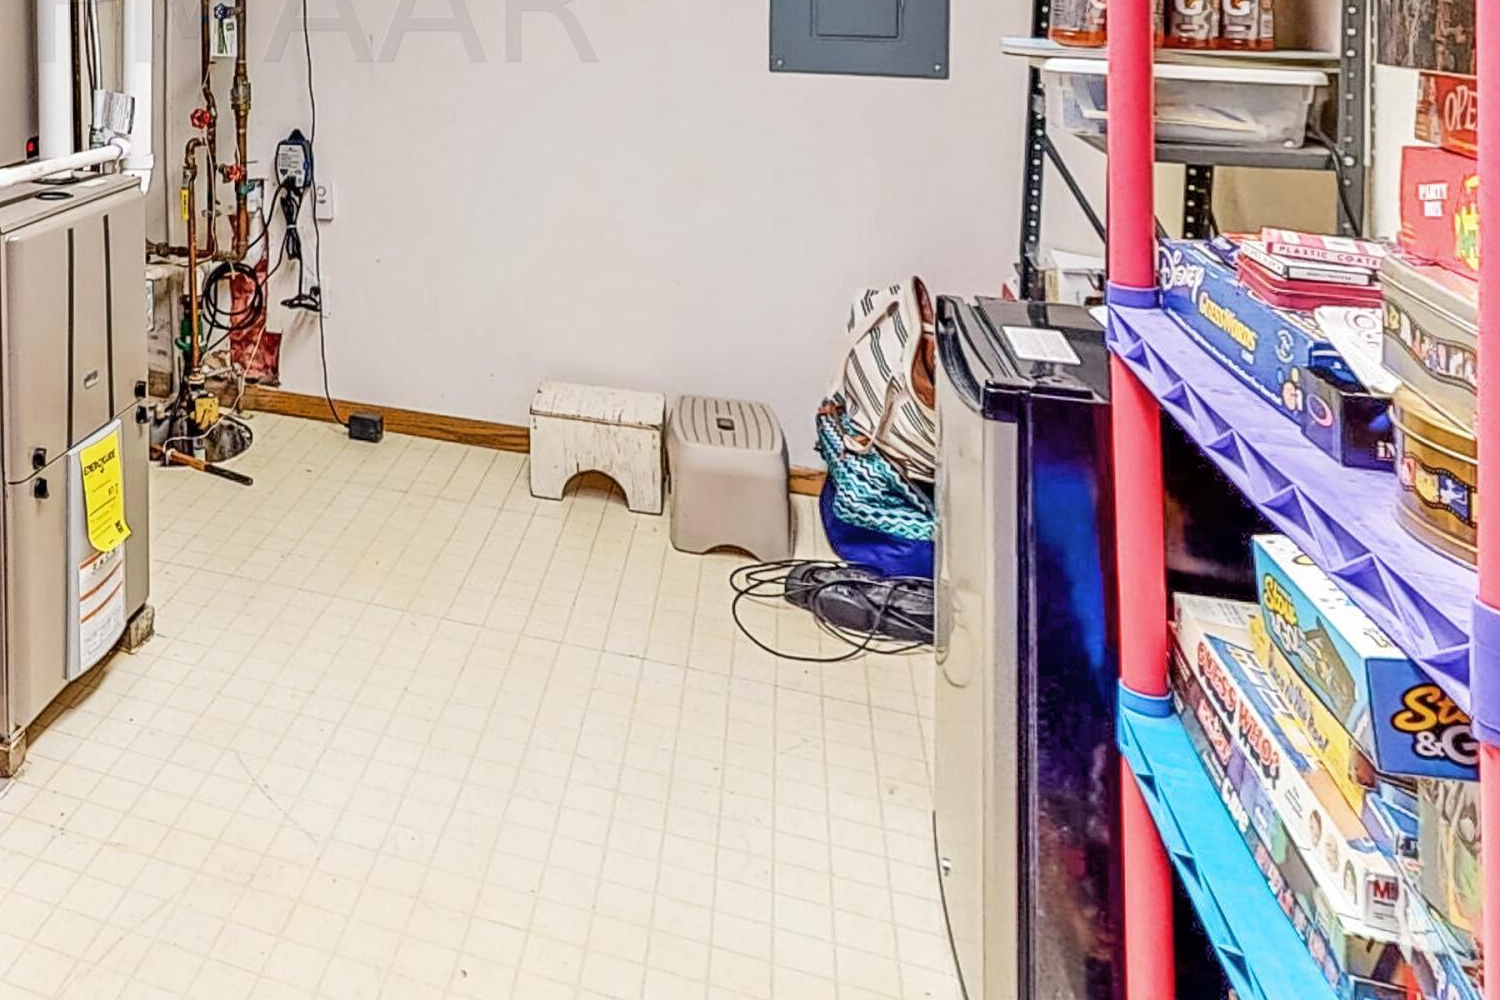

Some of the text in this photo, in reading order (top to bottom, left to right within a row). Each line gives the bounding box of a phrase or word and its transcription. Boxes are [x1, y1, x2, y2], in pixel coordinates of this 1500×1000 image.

[1444, 85, 1478, 131] OPE
[1159, 246, 1205, 302] Disney
[1279, 246, 1329, 259] PLASTIC
[1337, 254, 1379, 266] COATE
